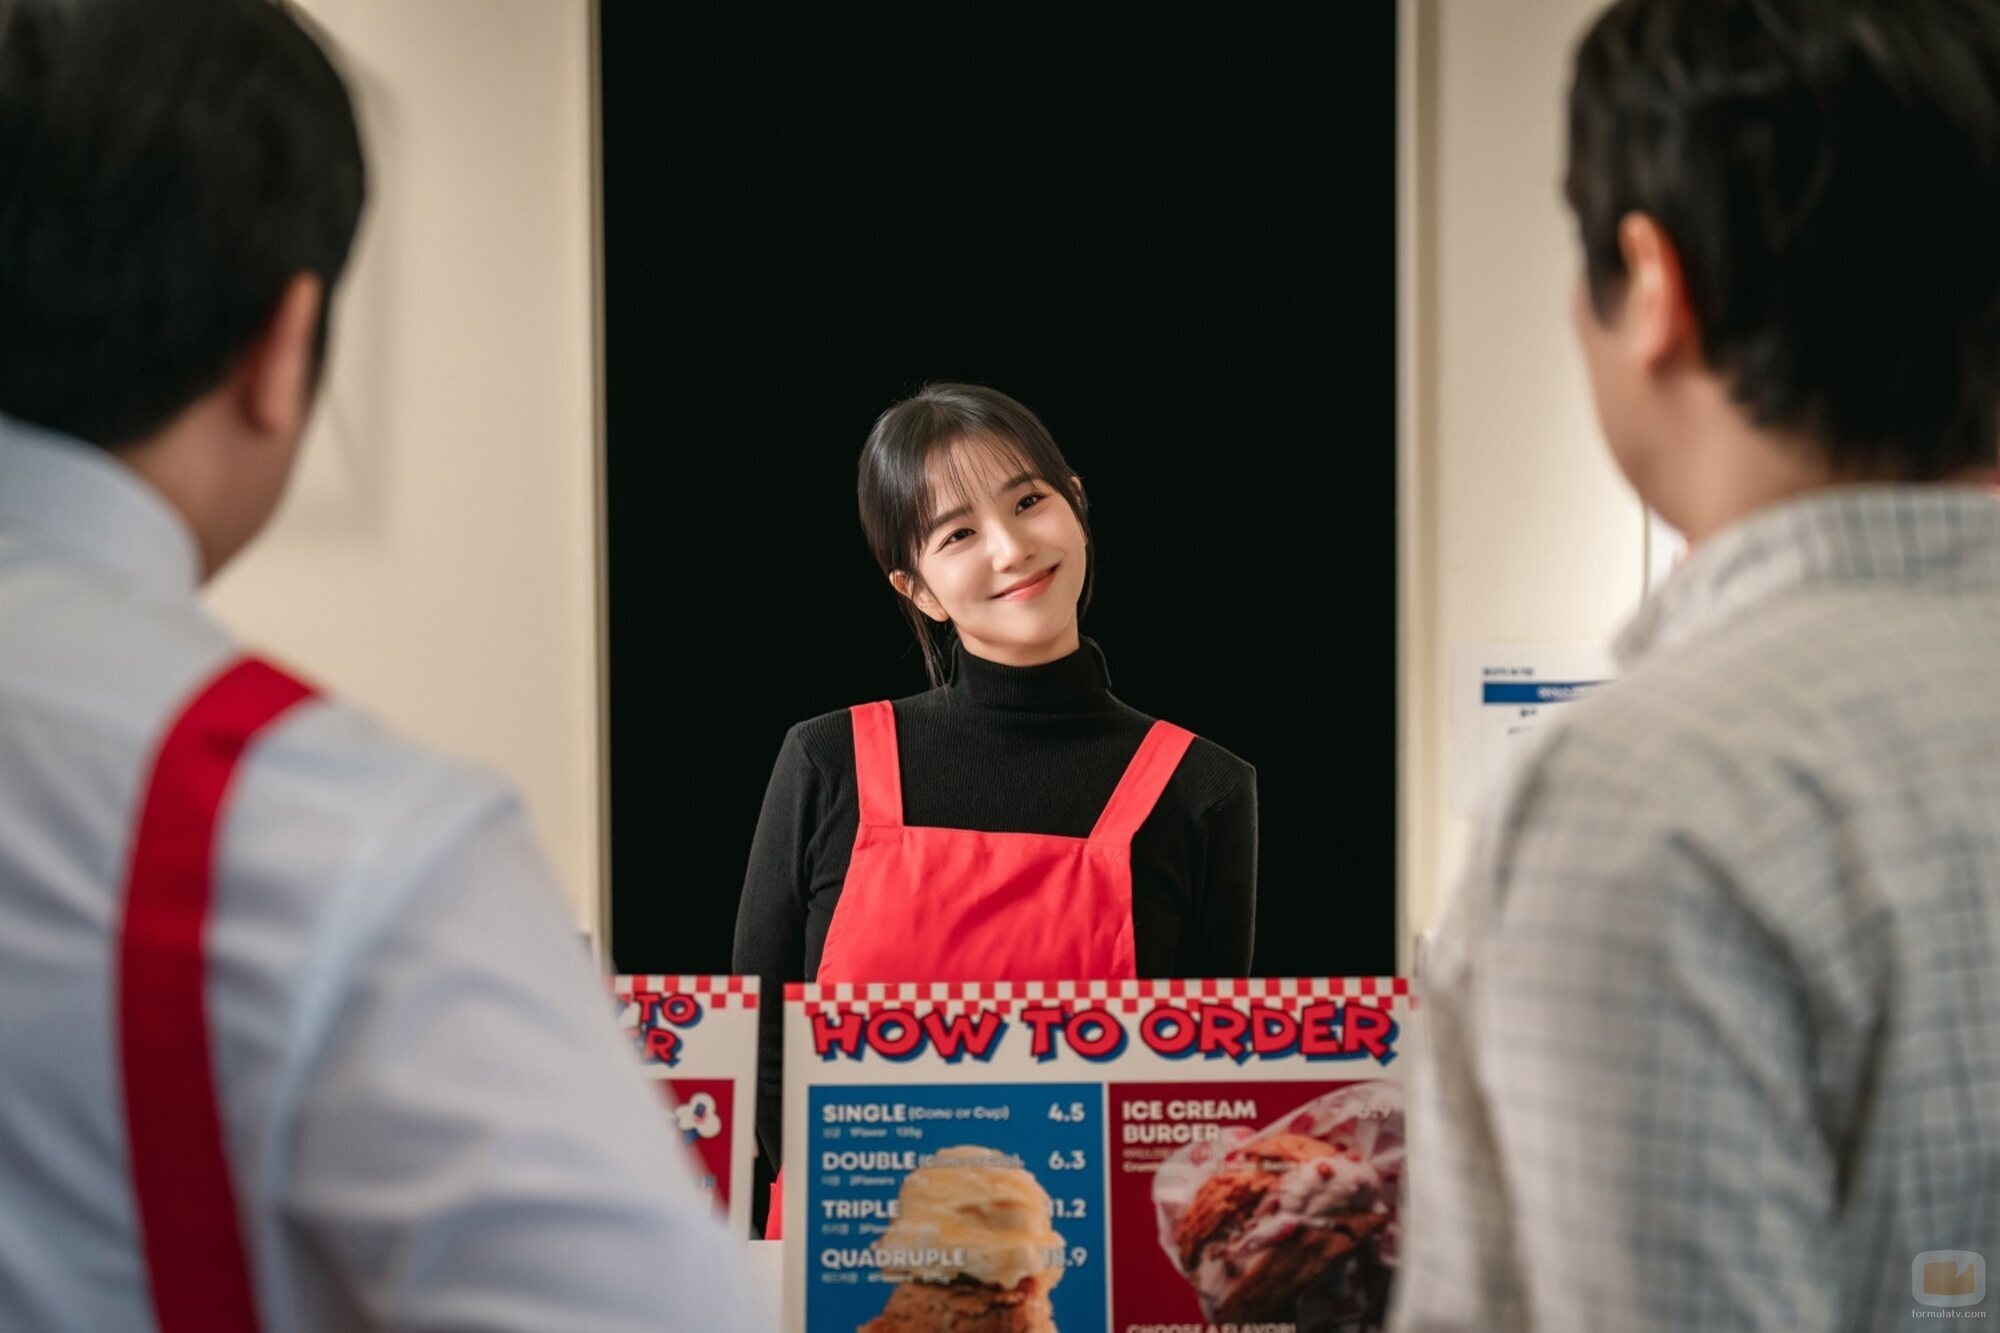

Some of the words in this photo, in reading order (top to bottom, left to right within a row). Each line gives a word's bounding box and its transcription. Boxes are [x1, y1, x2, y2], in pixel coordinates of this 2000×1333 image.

[634, 991, 703, 1028] TO
[811, 1007, 1009, 1064] HOW
[1021, 1005, 1128, 1063] TO
[1140, 1001, 1399, 1066] ORDER
[822, 1104, 906, 1123] SINGLE
[1048, 1103, 1085, 1122] 4.5
[1122, 1101, 1163, 1120] ICE
[1167, 1100, 1257, 1119] CREAM
[1122, 1124, 1221, 1144] BURGER
[822, 1151, 917, 1171] DOUBLE
[1049, 1151, 1086, 1170] 6.3
[822, 1200, 899, 1219] TRIPLE
[820, 1247, 966, 1270] QUADRUPLE
